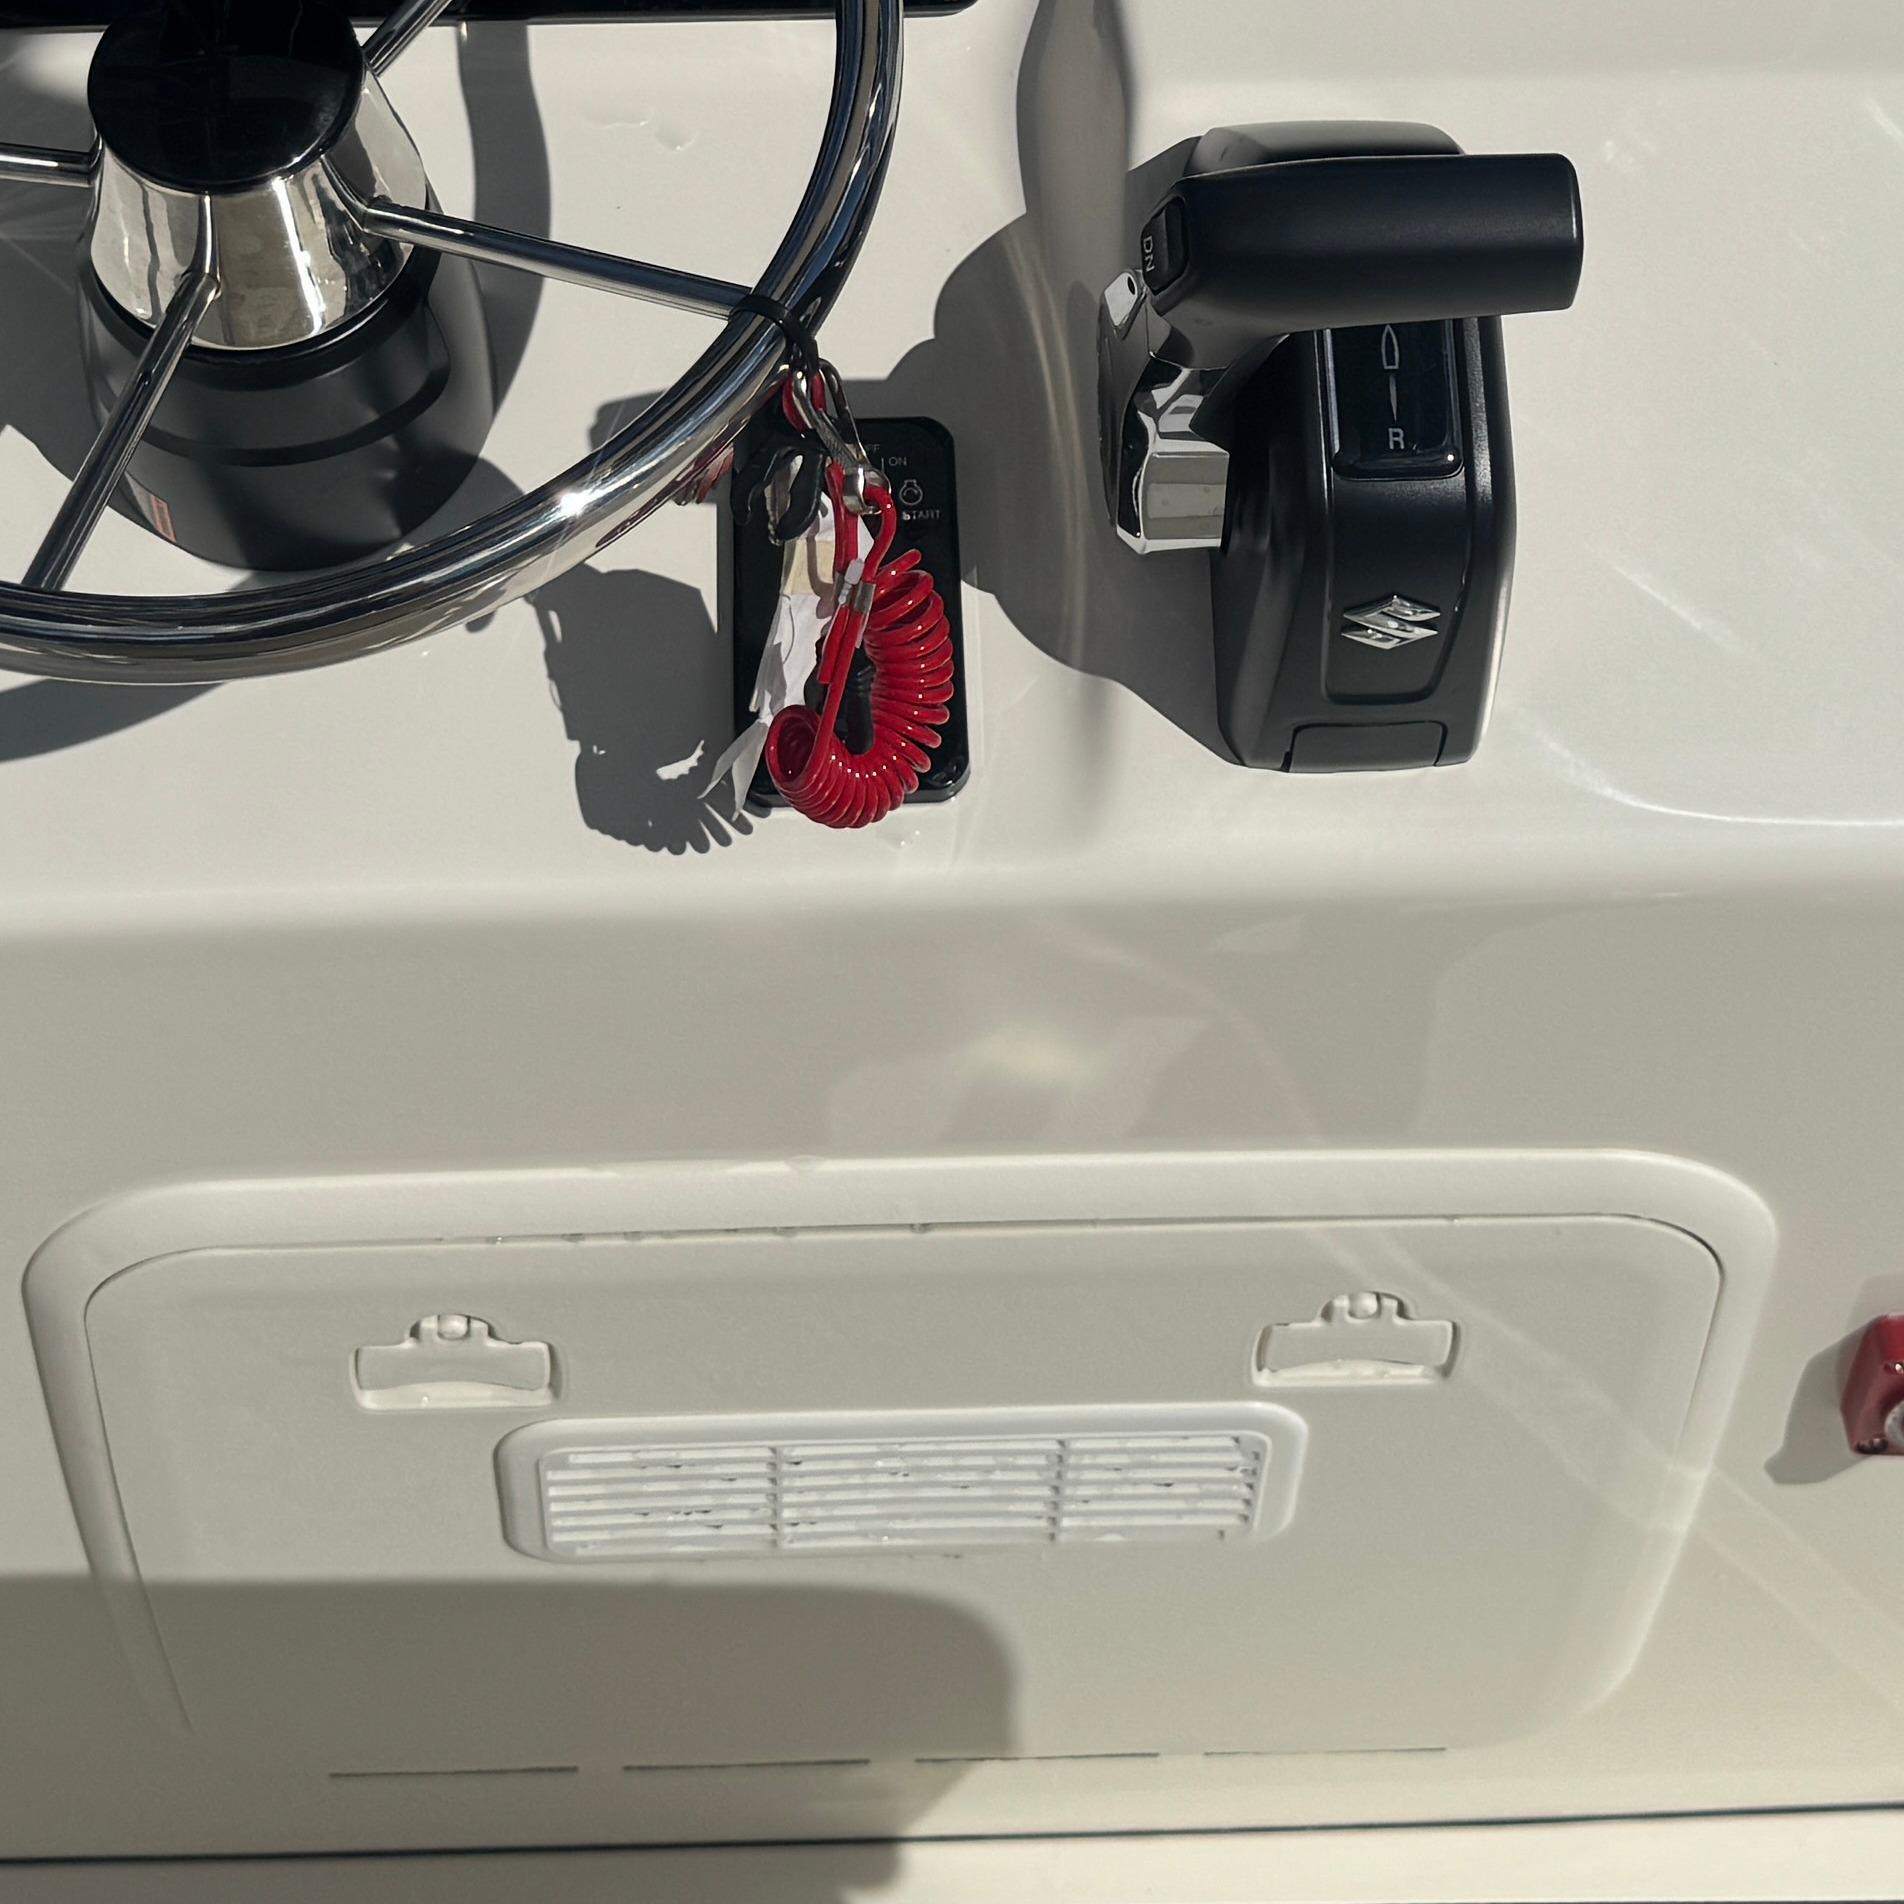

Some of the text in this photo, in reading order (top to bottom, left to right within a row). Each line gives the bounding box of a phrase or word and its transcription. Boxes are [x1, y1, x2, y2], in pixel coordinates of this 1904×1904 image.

[1143, 235, 1155, 272] DN
[1388, 427, 1406, 450] R
[888, 456, 908, 467] ON
